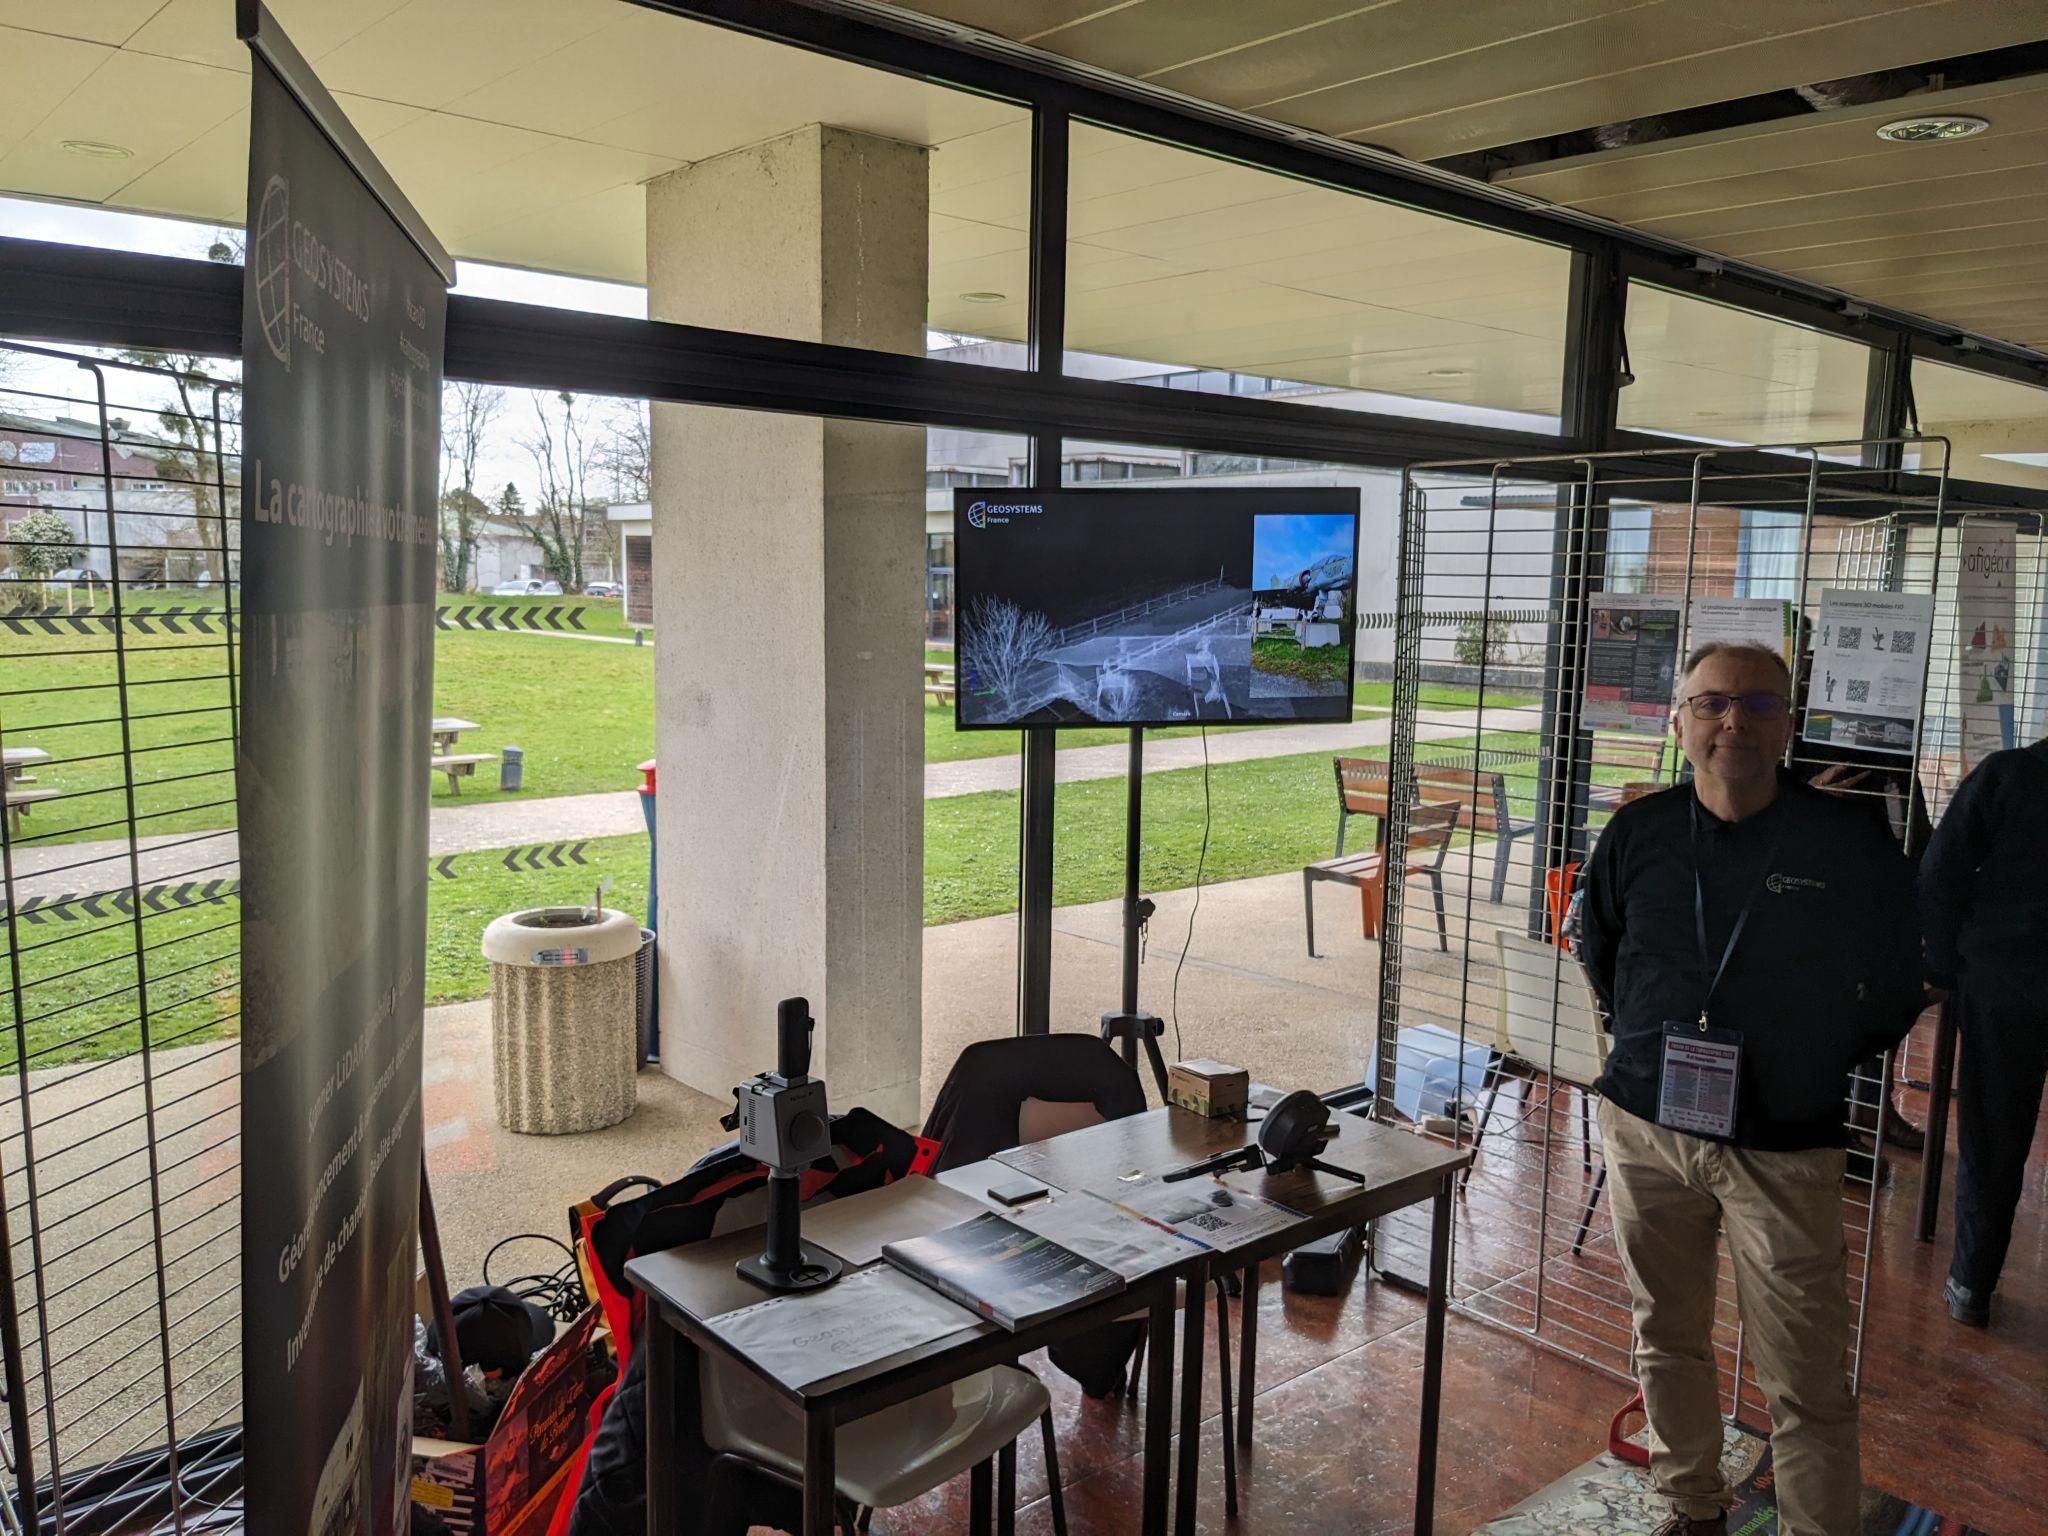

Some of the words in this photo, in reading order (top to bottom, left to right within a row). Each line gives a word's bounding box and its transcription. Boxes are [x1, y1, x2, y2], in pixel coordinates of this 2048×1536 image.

[293, 302, 325, 355] France
[254, 458, 283, 525] La
[986, 505, 1043, 514] GEOSYSTEMS
[323, 1239, 336, 1275] de
